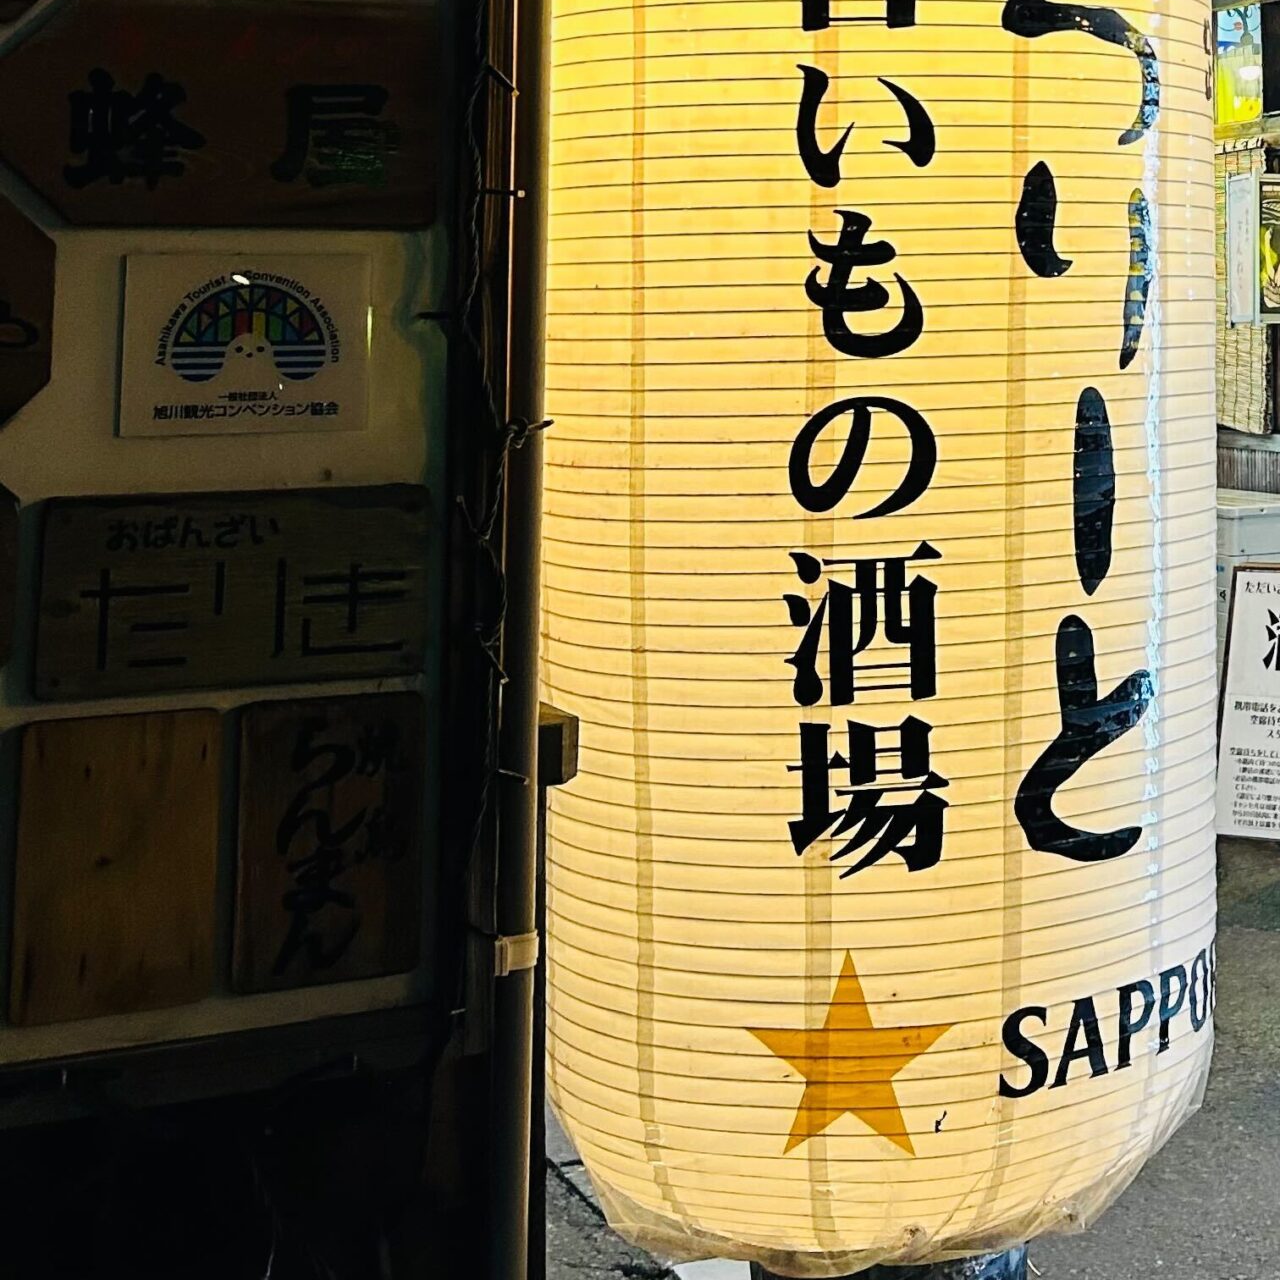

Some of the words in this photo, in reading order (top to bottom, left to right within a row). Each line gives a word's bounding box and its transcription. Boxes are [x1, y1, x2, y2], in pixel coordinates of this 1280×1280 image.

[154, 300, 187, 366] Asahikawa
[184, 275, 227, 303] Tourist
[310, 297, 341, 364] Association
[152, 400, 339, 420] 旭川観光コンベンション協会
[105, 516, 280, 551] おばんざい
